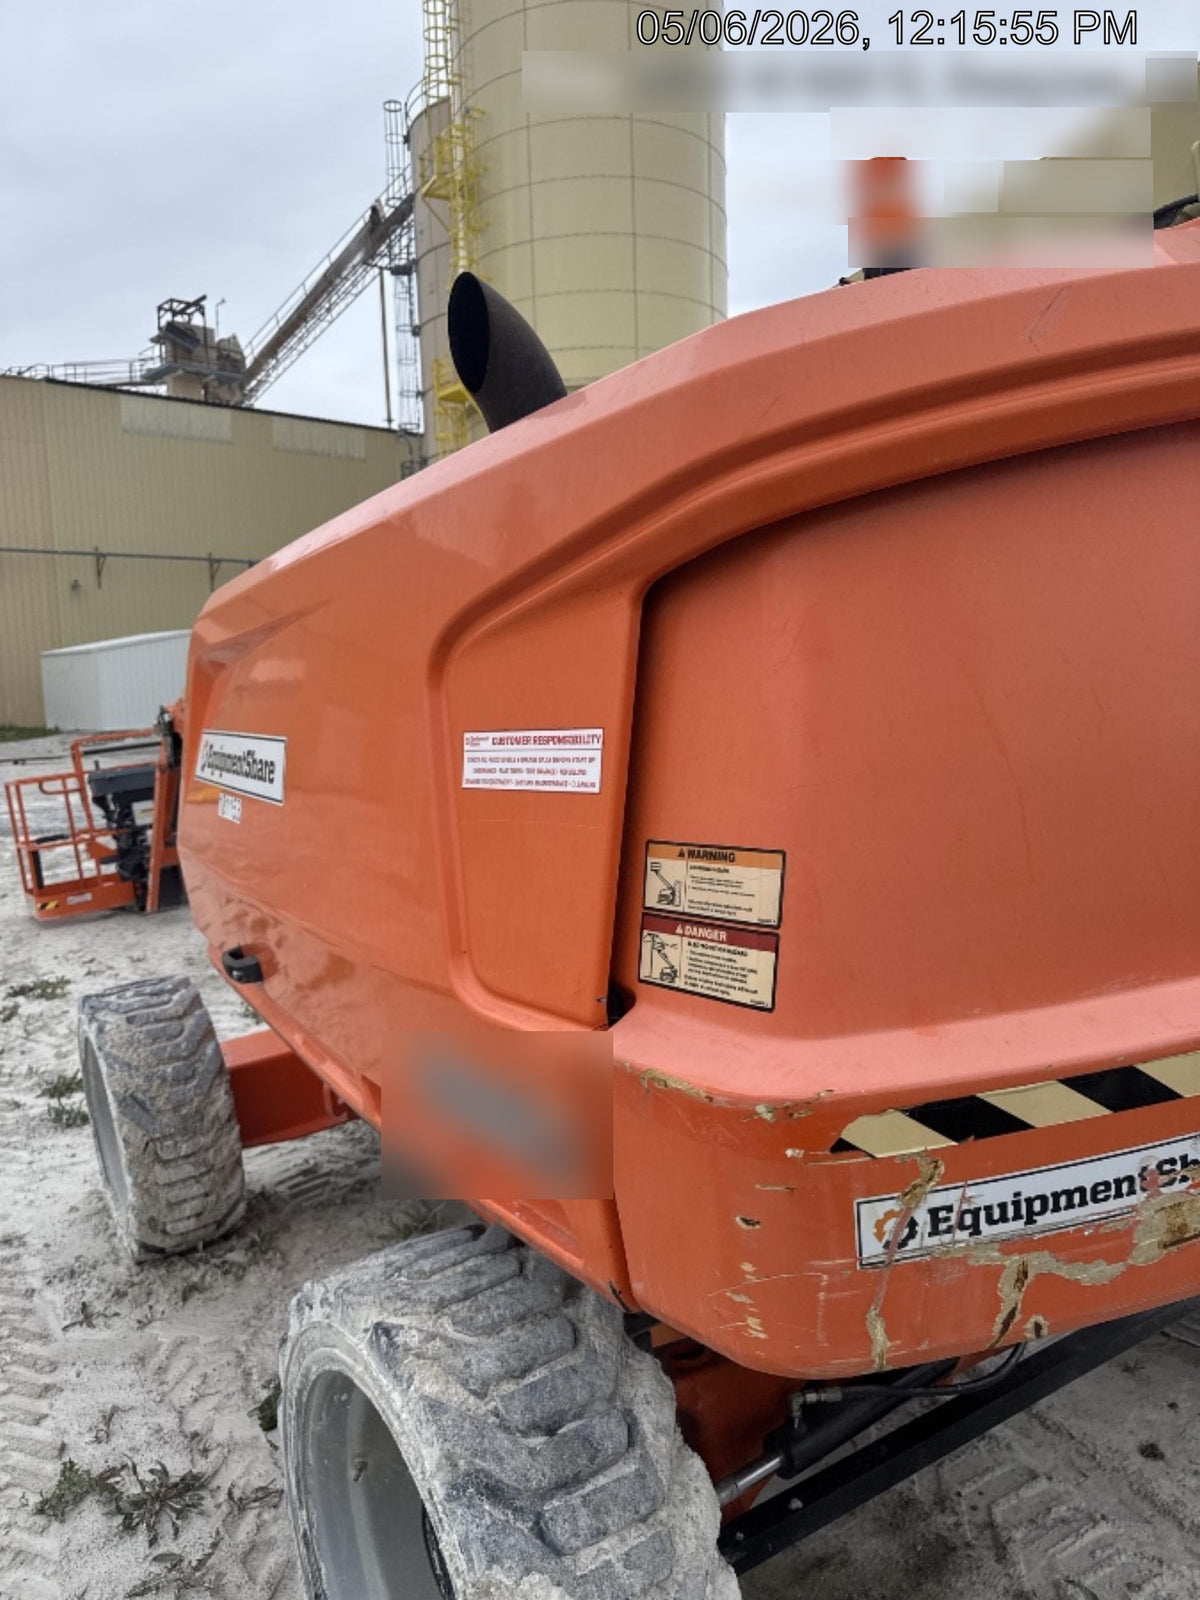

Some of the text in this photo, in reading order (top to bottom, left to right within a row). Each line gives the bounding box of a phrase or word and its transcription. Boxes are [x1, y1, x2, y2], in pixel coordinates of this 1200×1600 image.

[492, 734, 532, 746] CUSTOMER
[687, 849, 736, 863] WARNING
[684, 925, 728, 942] DANGER
